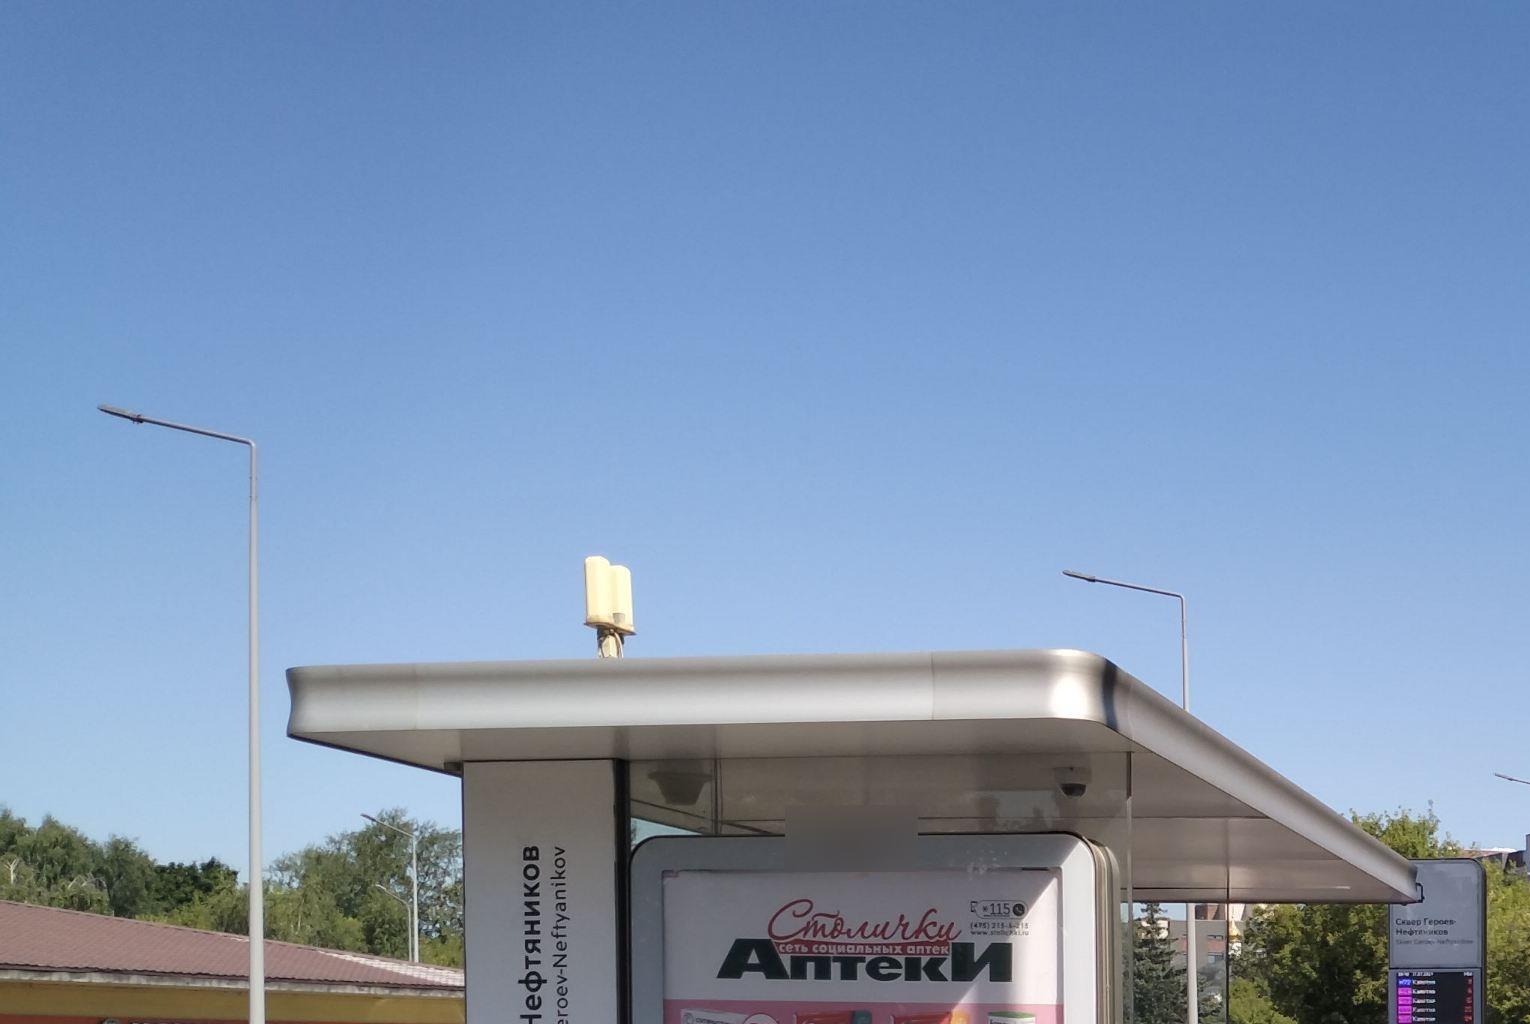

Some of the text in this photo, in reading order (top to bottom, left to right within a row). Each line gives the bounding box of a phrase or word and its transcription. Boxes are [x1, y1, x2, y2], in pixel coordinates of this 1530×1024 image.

[768, 898, 962, 942] Столички
[1396, 918, 1422, 926] Сквер
[779, 944, 949, 956] сеть социальных аптек
